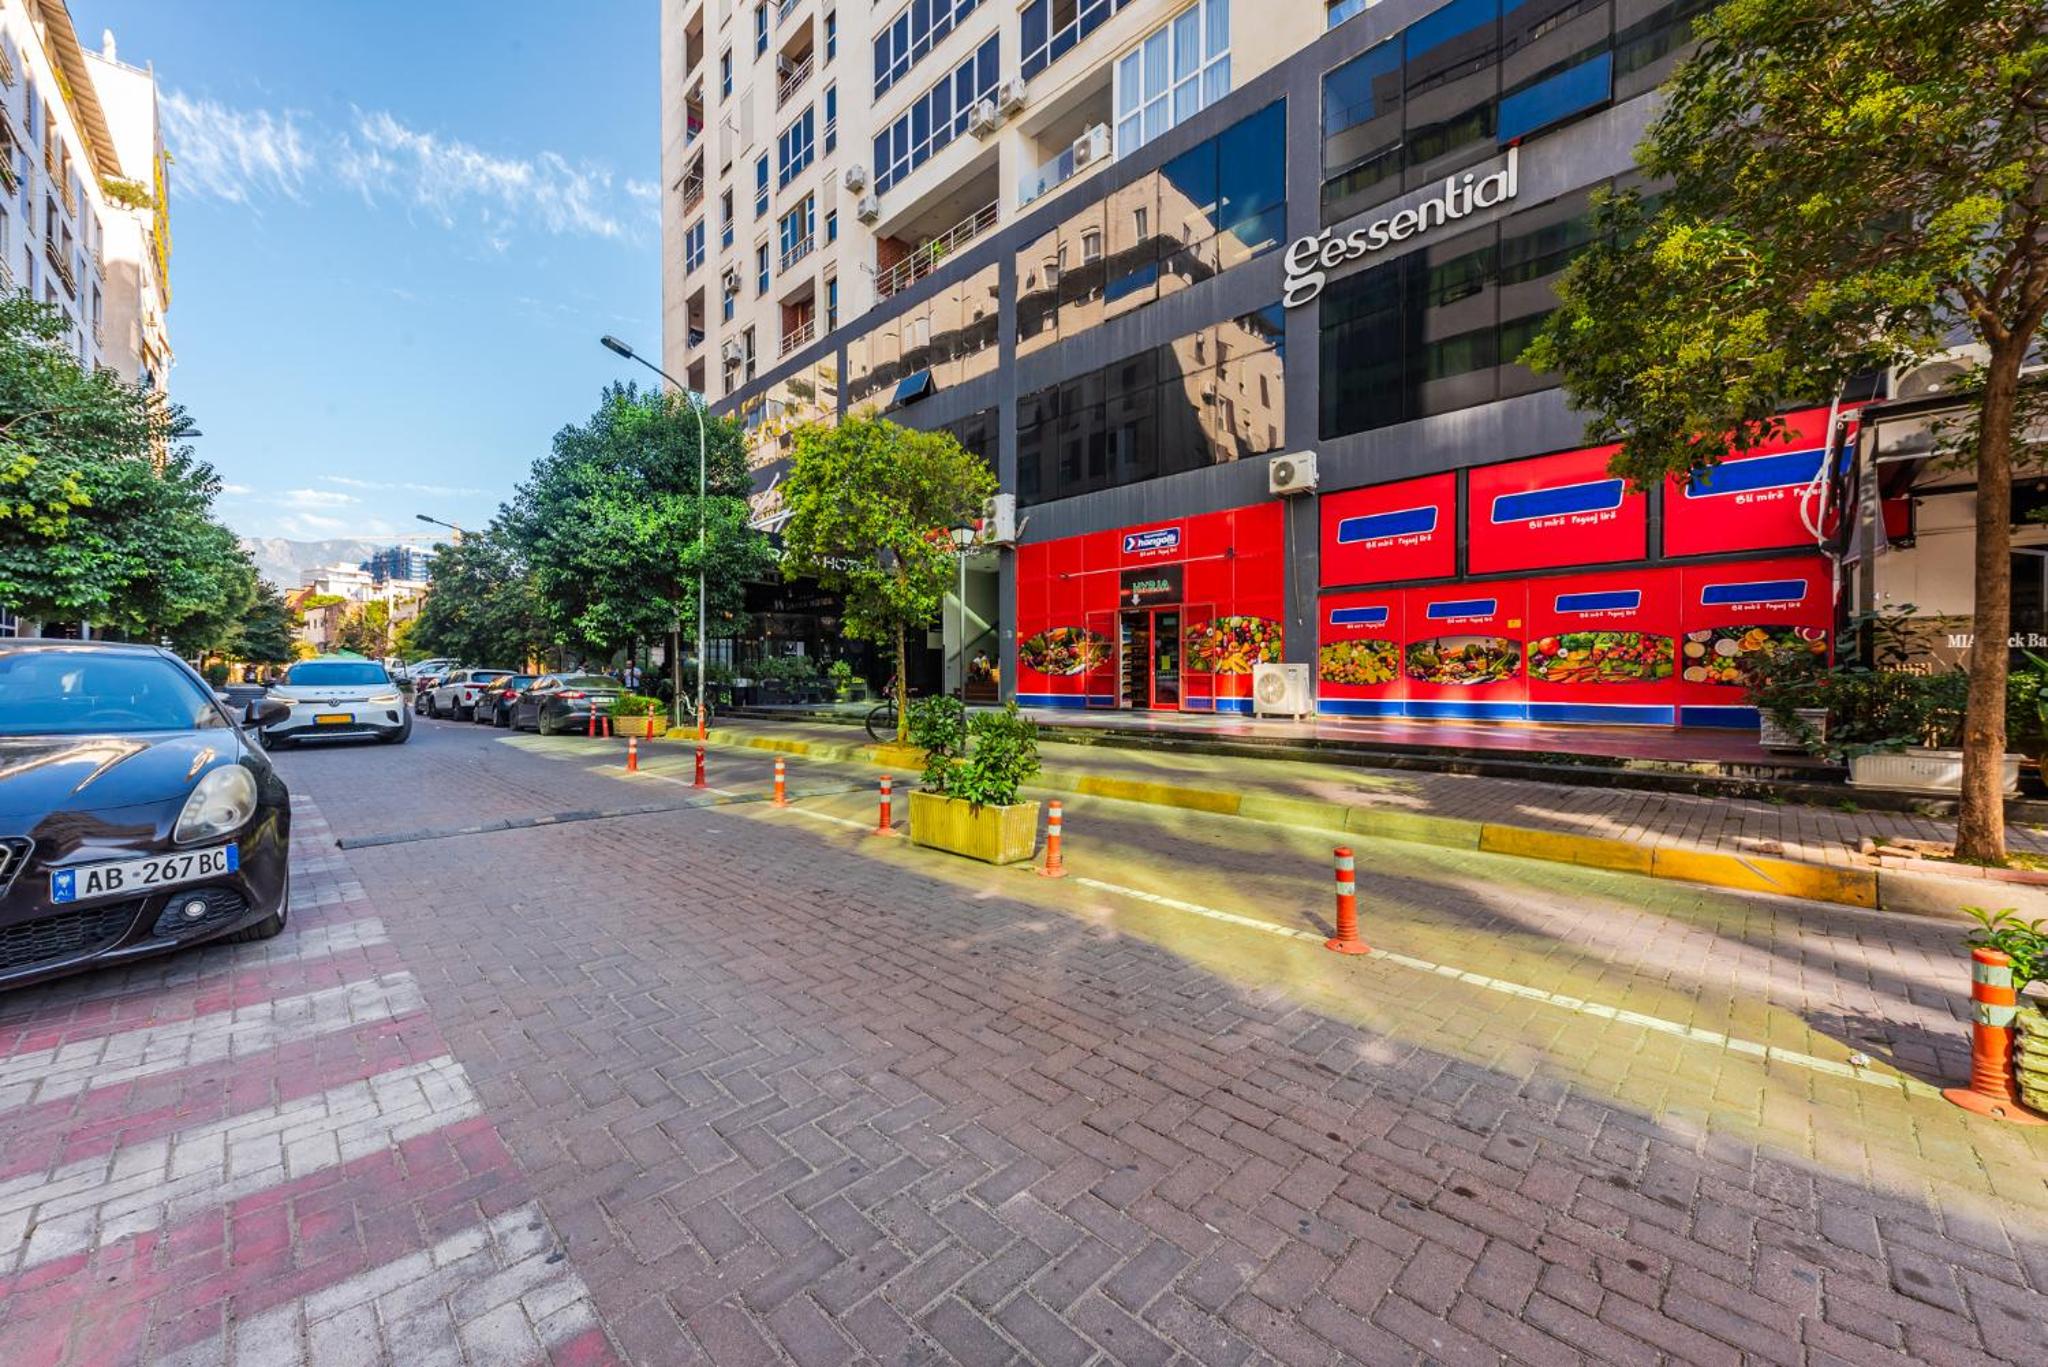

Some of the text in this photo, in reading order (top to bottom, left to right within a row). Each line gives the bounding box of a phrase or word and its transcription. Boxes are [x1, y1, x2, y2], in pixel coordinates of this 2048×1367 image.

[85, 850, 226, 894] AB 267 BC
